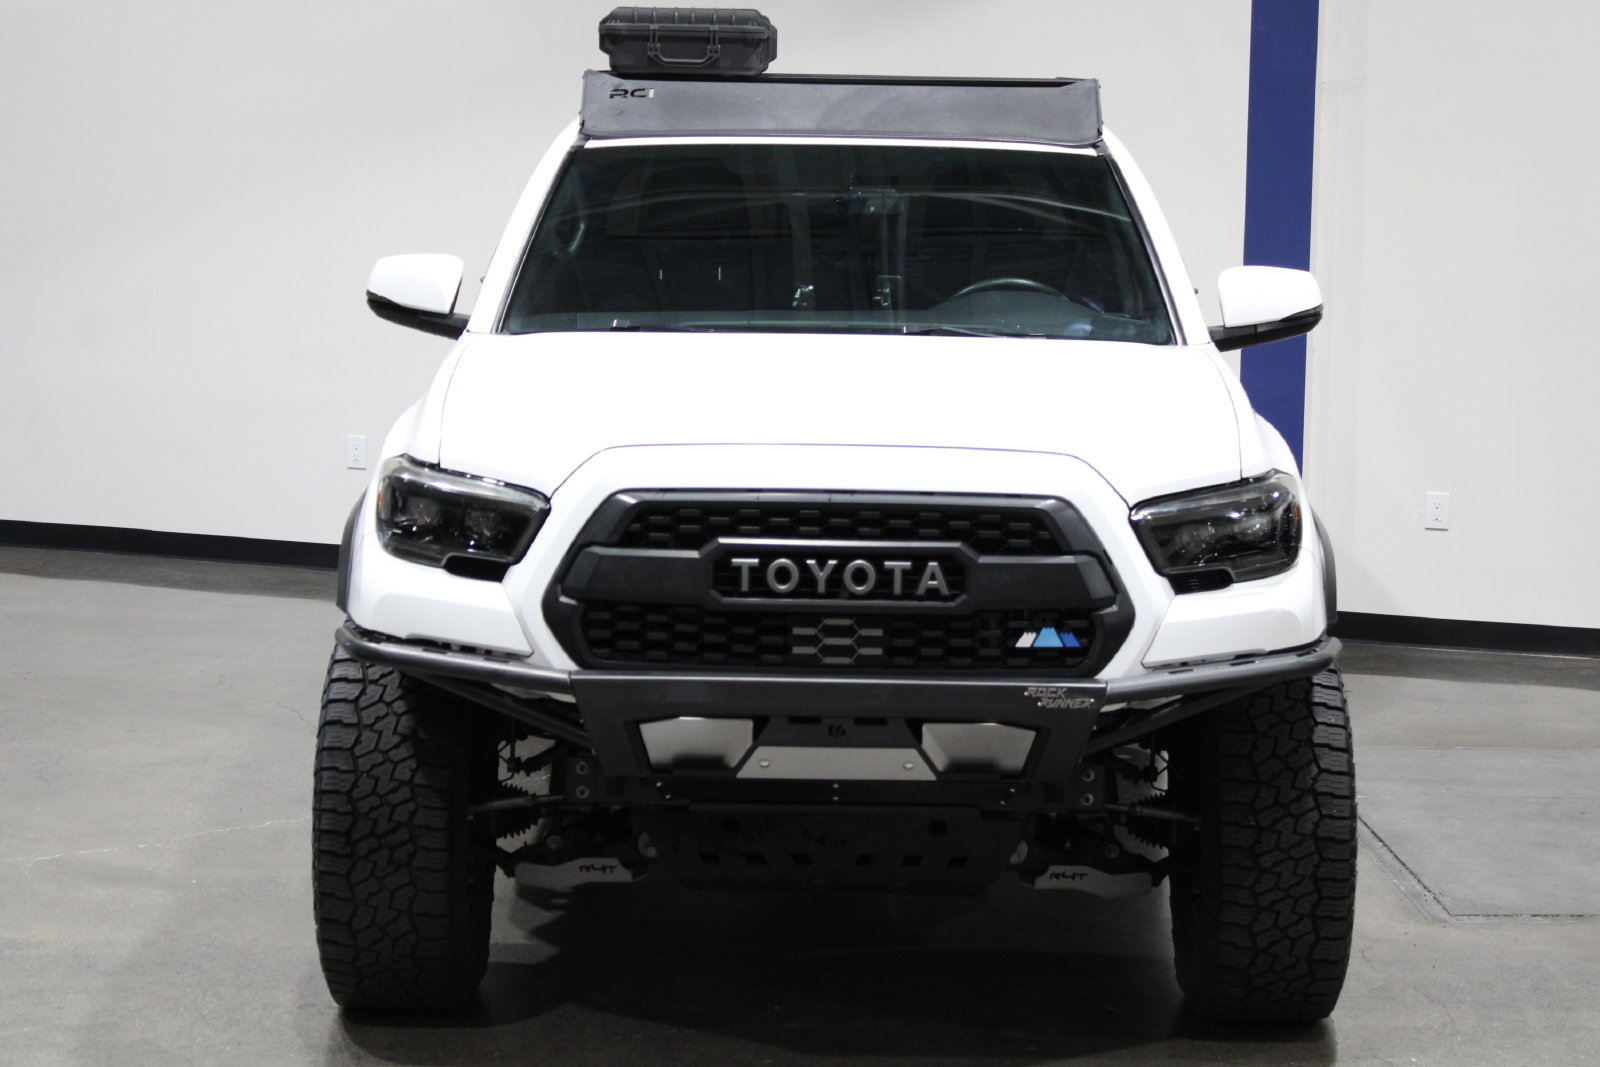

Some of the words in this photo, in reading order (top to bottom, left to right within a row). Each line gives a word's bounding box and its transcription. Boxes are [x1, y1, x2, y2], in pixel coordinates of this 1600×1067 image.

[609, 88, 655, 99] RCI
[731, 558, 950, 596] TOYOTA
[1024, 687, 1068, 698] ROCK
[1038, 698, 1094, 709] RUNNER
